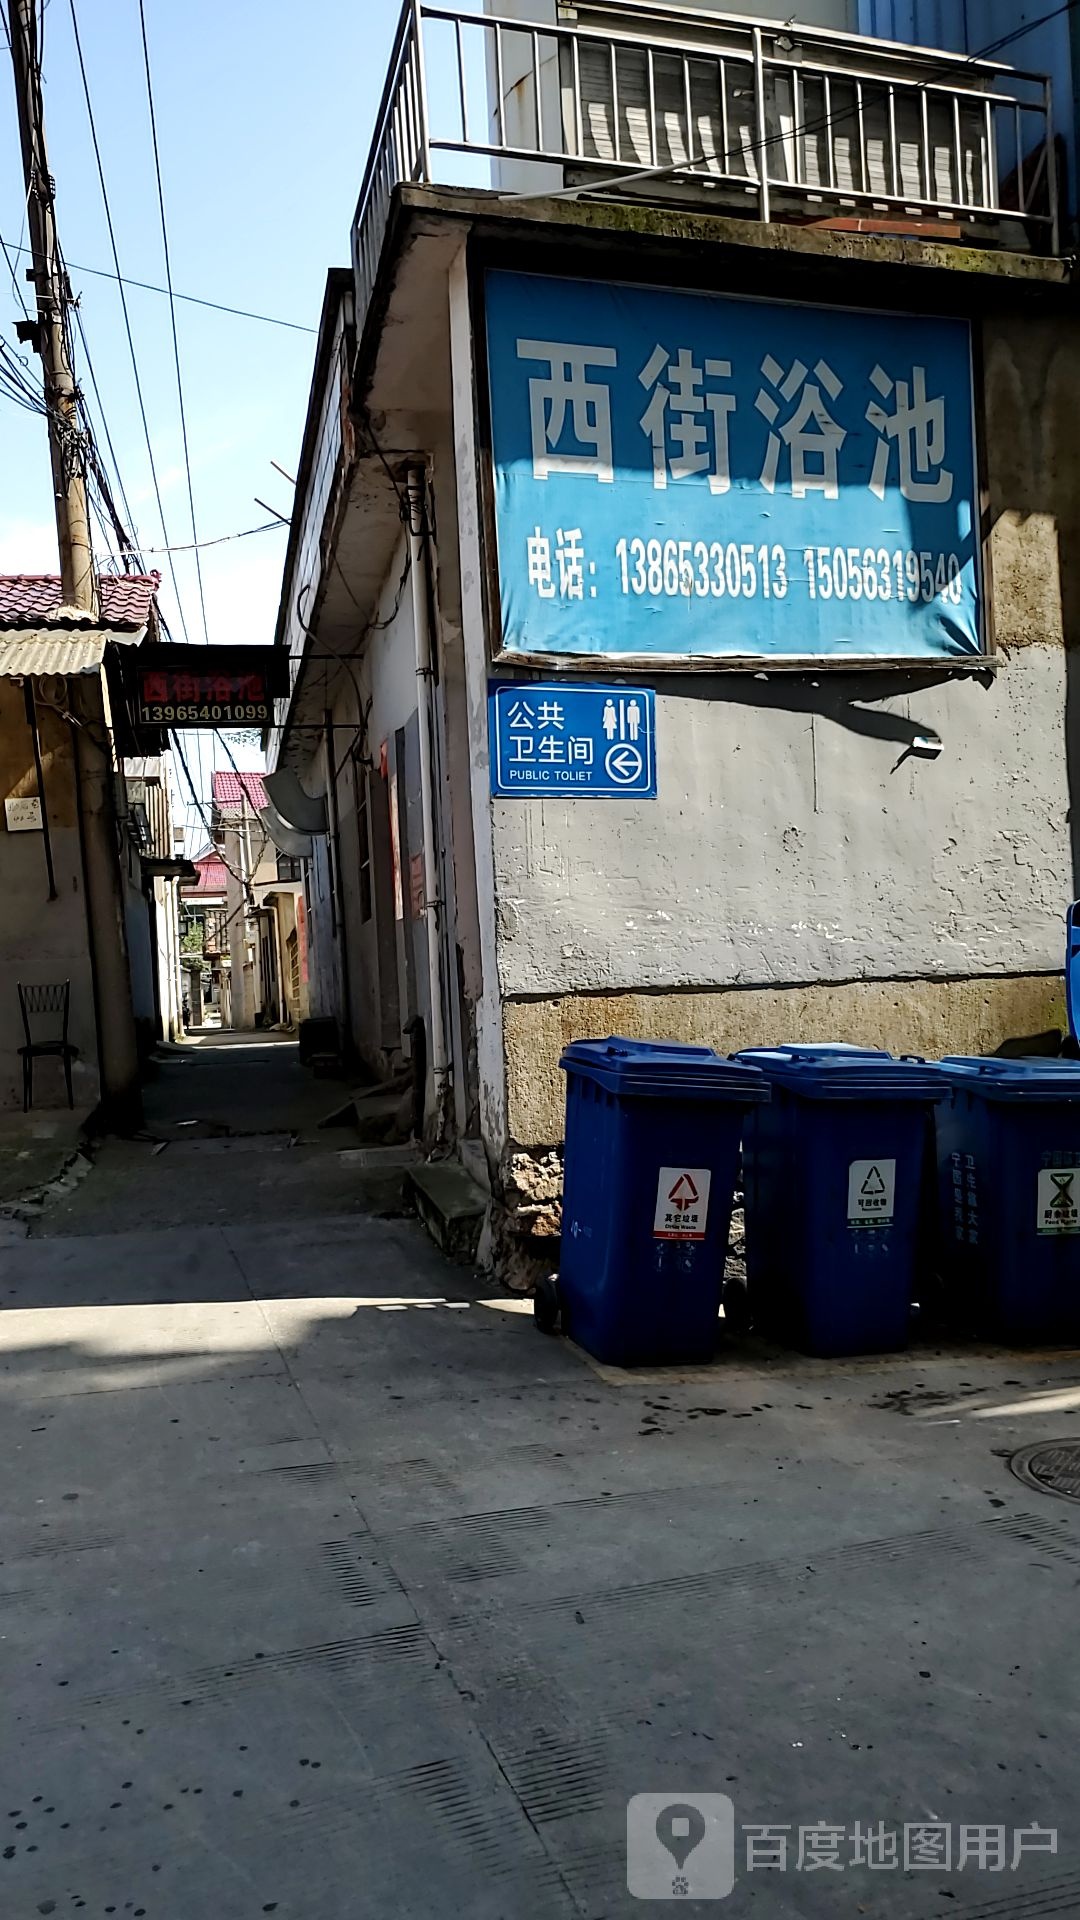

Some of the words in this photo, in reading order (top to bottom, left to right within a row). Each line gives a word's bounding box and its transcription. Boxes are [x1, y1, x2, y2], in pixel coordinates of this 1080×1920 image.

[516, 338, 953, 503] 西街浴池
[616, 537, 788, 599] 13865330513
[804, 545, 964, 605] 15056319540
[142, 704, 268, 720] 13965401099
[508, 701, 565, 730] 公共
[509, 735, 594, 765] 卫生间
[509, 770, 550, 780] PUBLIC
[554, 770, 592, 781] TOLIET
